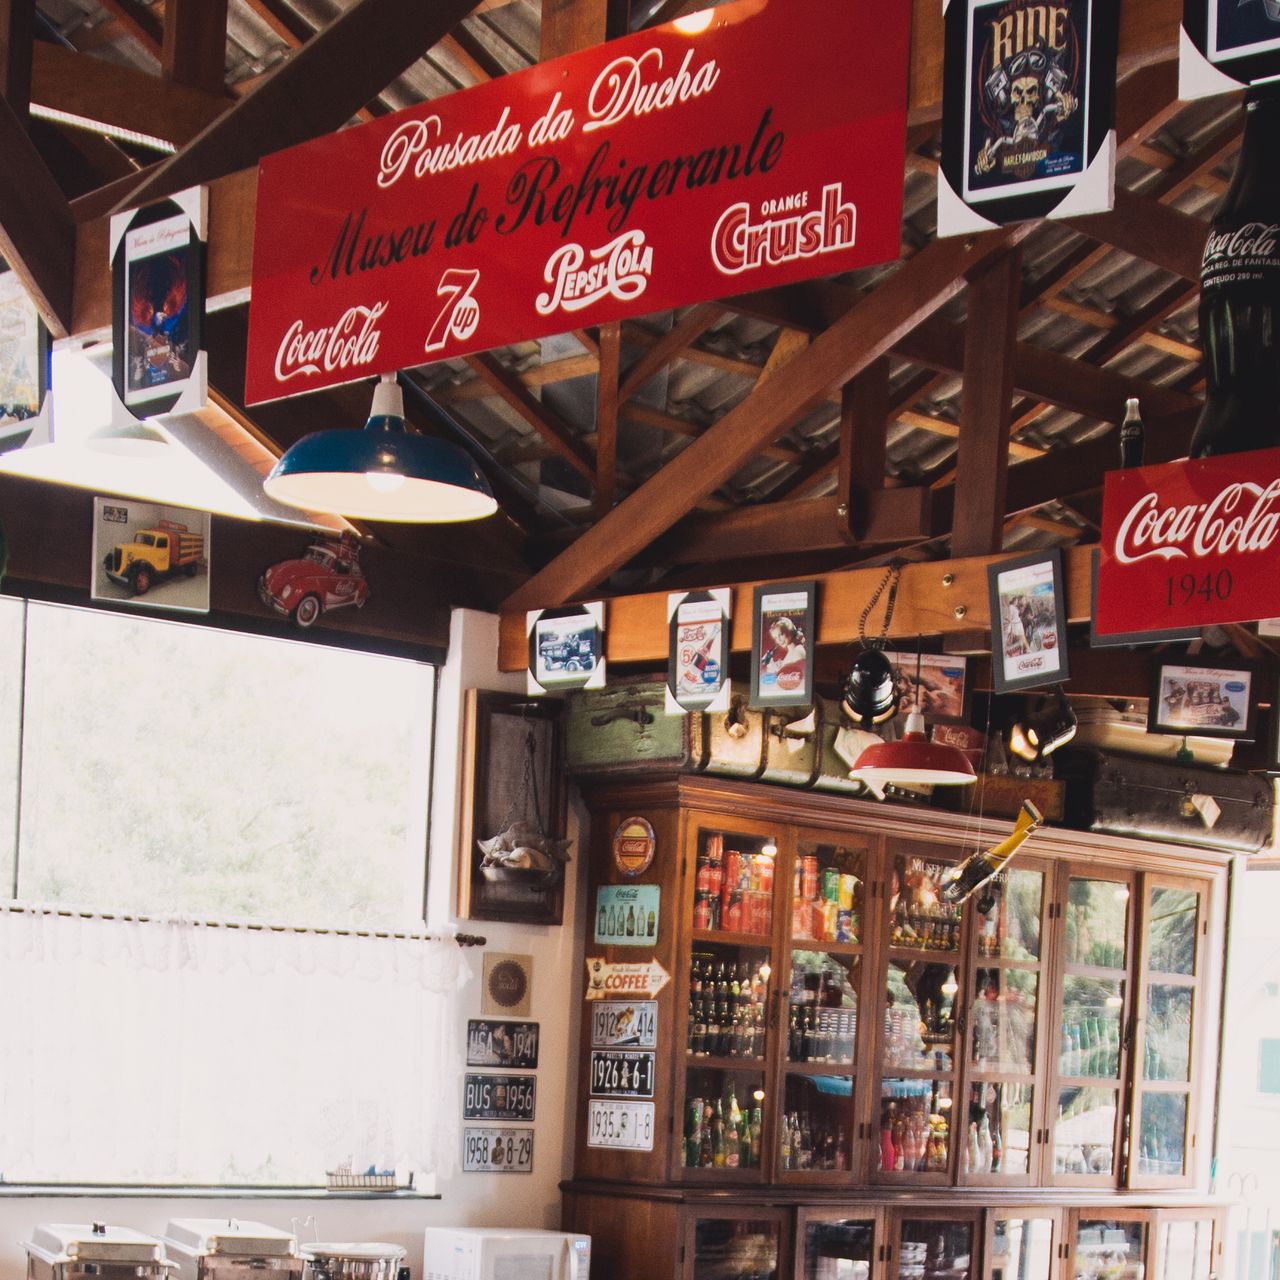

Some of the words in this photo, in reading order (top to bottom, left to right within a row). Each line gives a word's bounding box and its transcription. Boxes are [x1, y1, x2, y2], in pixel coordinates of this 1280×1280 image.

[992, 5, 1069, 70] RIDE
[376, 115, 523, 189] Pousada
[528, 102, 575, 146] da
[587, 48, 721, 131] Ducha
[310, 207, 438, 285] Museu
[444, 188, 490, 248] do
[494, 106, 787, 238] Refrigerante
[760, 190, 810, 218] ORANGE
[710, 182, 858, 276] Crush
[1232, 258, 1243, 267] DE
[275, 300, 390, 382] Coca-Cola
[1167, 568, 1234, 607] 1940
[615, 889, 639, 899] Coca-Cola
[604, 973, 650, 990] COFFEE
[594, 1012, 616, 1038] 1912
[637, 1012, 655, 1038] 414
[470, 1031, 493, 1057] USA
[513, 1033, 537, 1058] 1941
[593, 1060, 619, 1088] 1926
[633, 1061, 652, 1090] 6-1
[466, 1083, 491, 1109] BUS
[505, 1086, 533, 1110] 1956
[591, 1111, 615, 1138] 1935
[466, 1136, 489, 1164] 1958
[506, 1137, 531, 1165] 8-29
